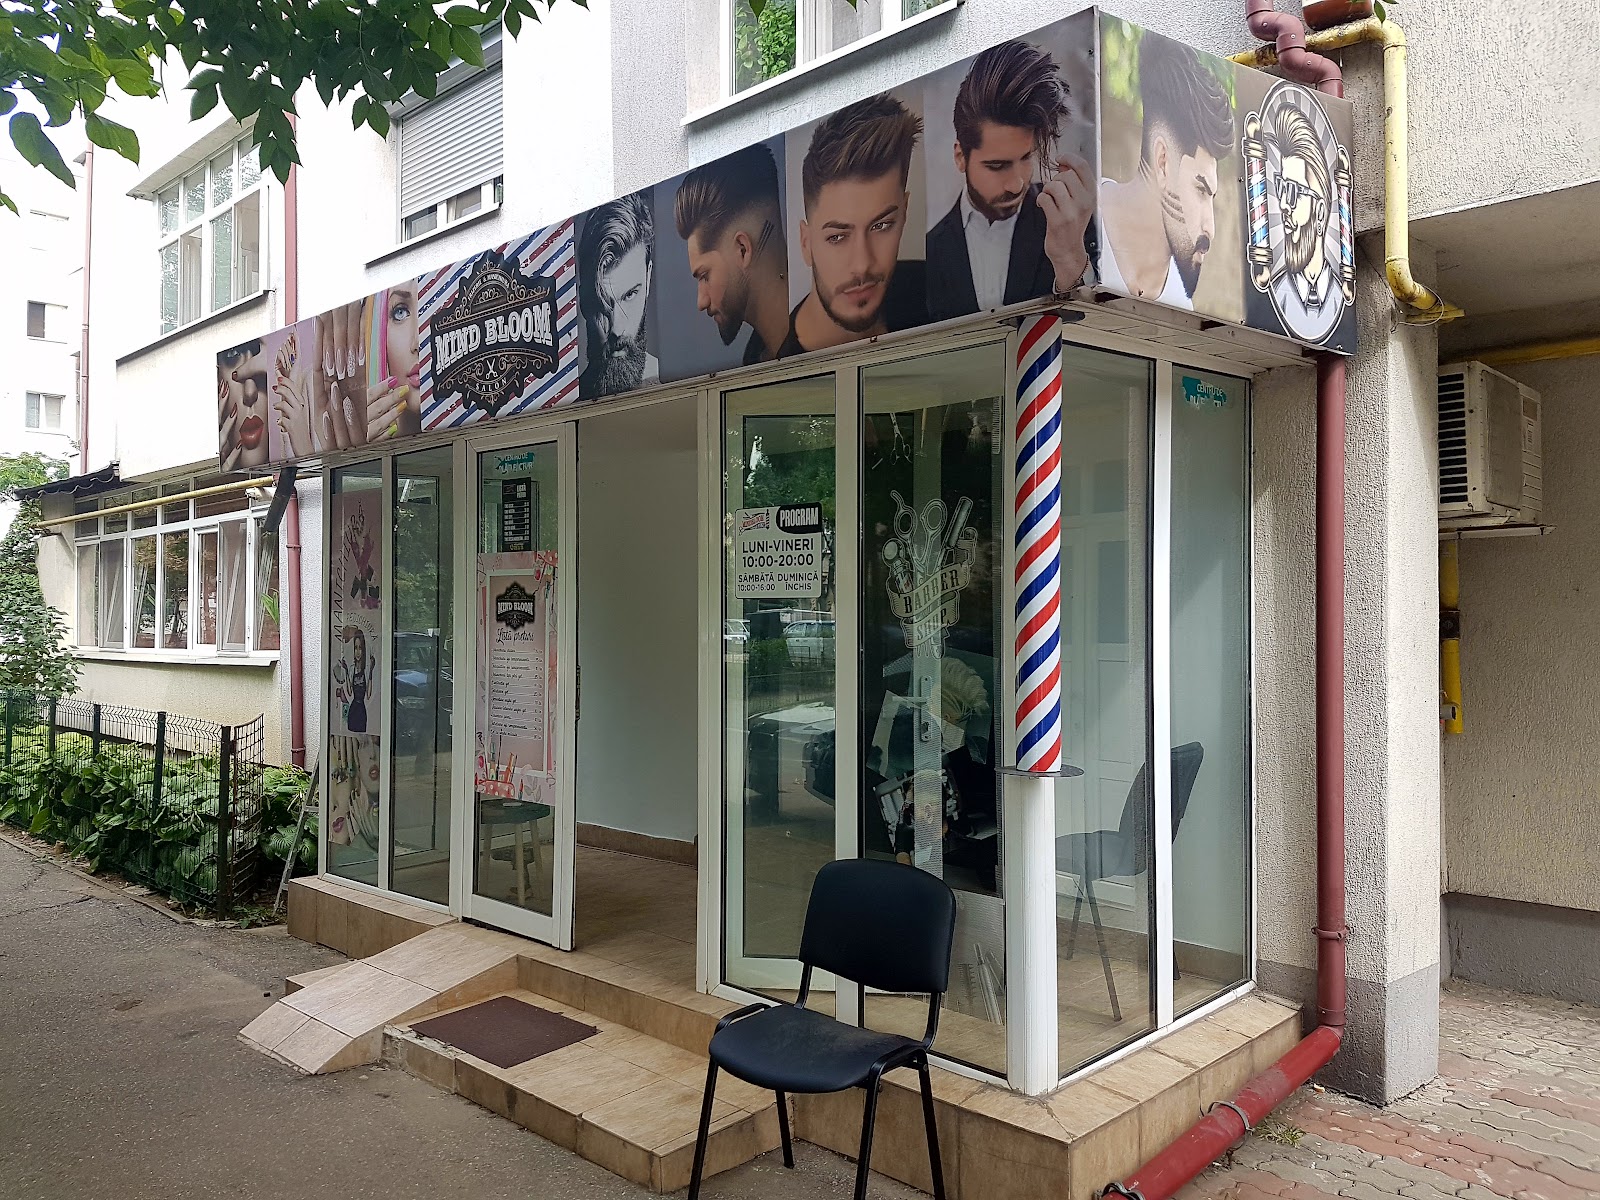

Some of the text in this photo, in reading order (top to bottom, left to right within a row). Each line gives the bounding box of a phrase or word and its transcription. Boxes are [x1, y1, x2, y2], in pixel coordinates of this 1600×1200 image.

[434, 301, 553, 375] MIND BLOOM
[476, 376, 507, 392] SALON
[780, 507, 819, 527] PROGRAM
[742, 538, 814, 553] LUNI-VINERI
[742, 554, 814, 568] 10:00-20:00
[738, 570, 819, 583] SÂMBĂTĂ DUMINICĂ
[785, 582, 812, 591] ÎNCHIS
[904, 569, 960, 614] BARBER
[917, 607, 947, 641] SHOP
